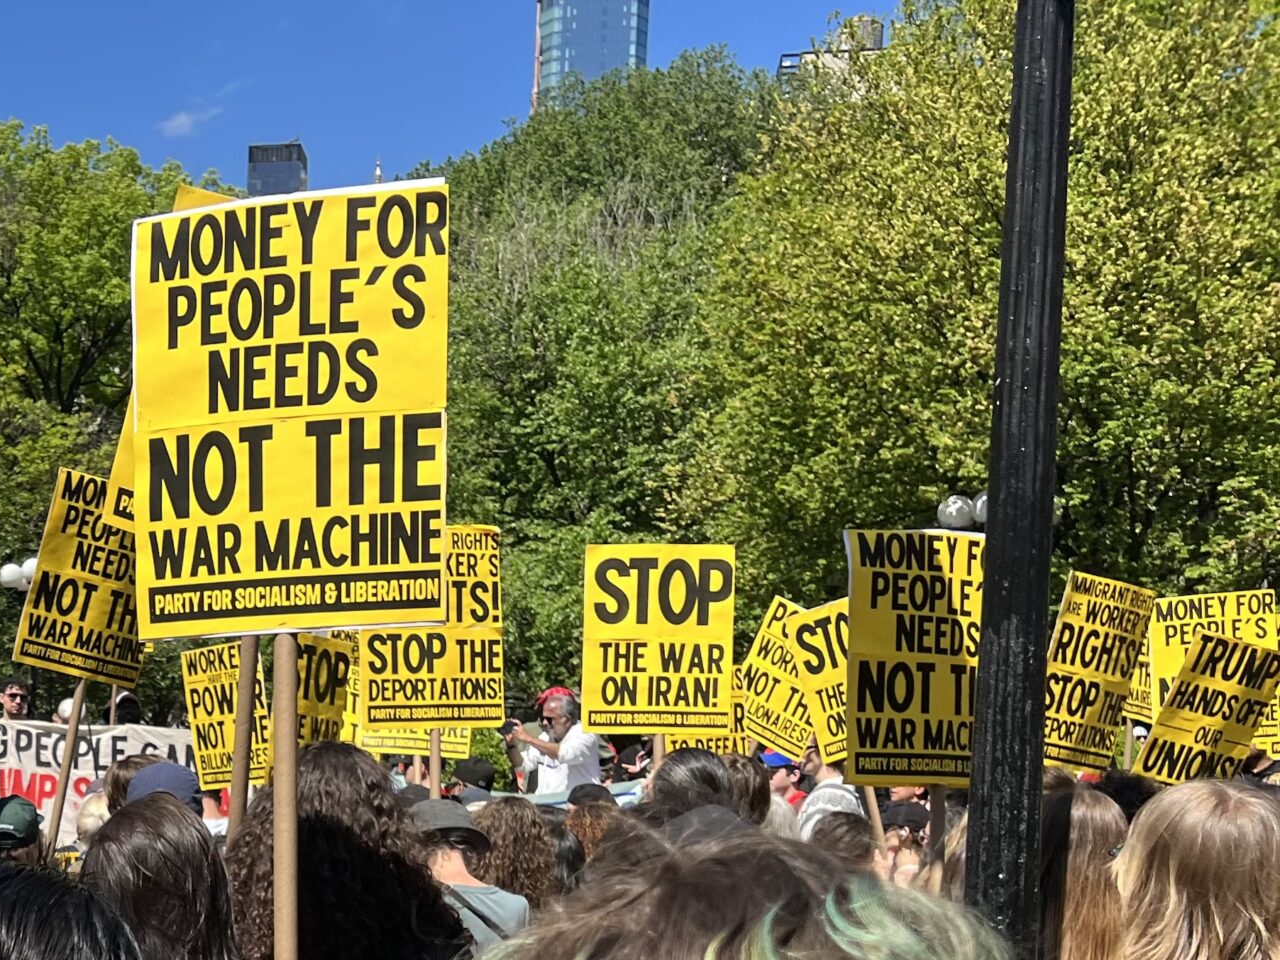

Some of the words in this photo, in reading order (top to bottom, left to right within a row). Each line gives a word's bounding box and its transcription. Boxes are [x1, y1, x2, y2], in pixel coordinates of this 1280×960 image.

[149, 199, 325, 283] MONEY
[346, 191, 448, 262] FOR
[168, 264, 426, 350] PEOPLE'S
[208, 338, 379, 414] NEEDS
[149, 424, 273, 522] NOT
[305, 413, 442, 508] THE
[61, 470, 107, 511] MON
[149, 523, 242, 580] WAR
[255, 510, 442, 573] MACHINE
[452, 532, 499, 551] RIGHTS
[858, 531, 958, 574] MONEY
[32, 570, 98, 623] NOT
[154, 590, 200, 615] PARTY
[202, 588, 233, 611] FOR
[235, 583, 321, 608] SOCIALISM
[324, 582, 338, 605] &
[340, 577, 439, 604] LIBERATION
[594, 557, 734, 626] STOP
[871, 571, 984, 617] PEOPLE'
[1071, 574, 1130, 606] IMMIGRANT
[1155, 595, 1228, 623] MONEY
[1236, 592, 1275, 617] FOR
[22, 642, 46, 658] PARTY
[46, 647, 61, 662] FOR
[27, 612, 73, 646] WAR
[74, 625, 146, 665] MACHINE
[367, 632, 447, 675] STOP
[456, 639, 502, 674] THE
[796, 612, 849, 675] STO
[896, 613, 981, 658] NEEDS
[1053, 621, 1142, 681] RIGHTS!
[186, 643, 241, 677] WORKE
[297, 643, 350, 706] TOP
[599, 642, 648, 673] THE
[659, 642, 725, 674] WAR
[368, 677, 503, 703] DEPORTATIONS!
[601, 675, 638, 706] ON
[647, 675, 719, 708] IRAN!
[744, 662, 782, 703] NOT
[857, 659, 936, 714] NOT
[1045, 672, 1101, 720] STOP
[1098, 690, 1127, 727] THE
[1170, 680, 1239, 722] HANDS
[370, 707, 396, 720] PARTY
[396, 707, 412, 720] FOR
[412, 706, 453, 720] SOCIALISM
[453, 706, 459, 719] &
[460, 705, 502, 719] LIBERATION
[590, 712, 616, 724] PARTY
[617, 712, 633, 725] FOR
[633, 713, 675, 725] SOCIALISM
[676, 713, 683, 725] &
[683, 713, 729, 726] LIBERATION
[195, 720, 226, 752] NOT
[855, 717, 917, 750] WAR
[1045, 716, 1118, 752] EPORTATIONS!
[1194, 725, 1224, 750] OUR
[858, 757, 888, 771] PARTY
[890, 757, 909, 771] FOR
[910, 758, 956, 773] SOCIALISM
